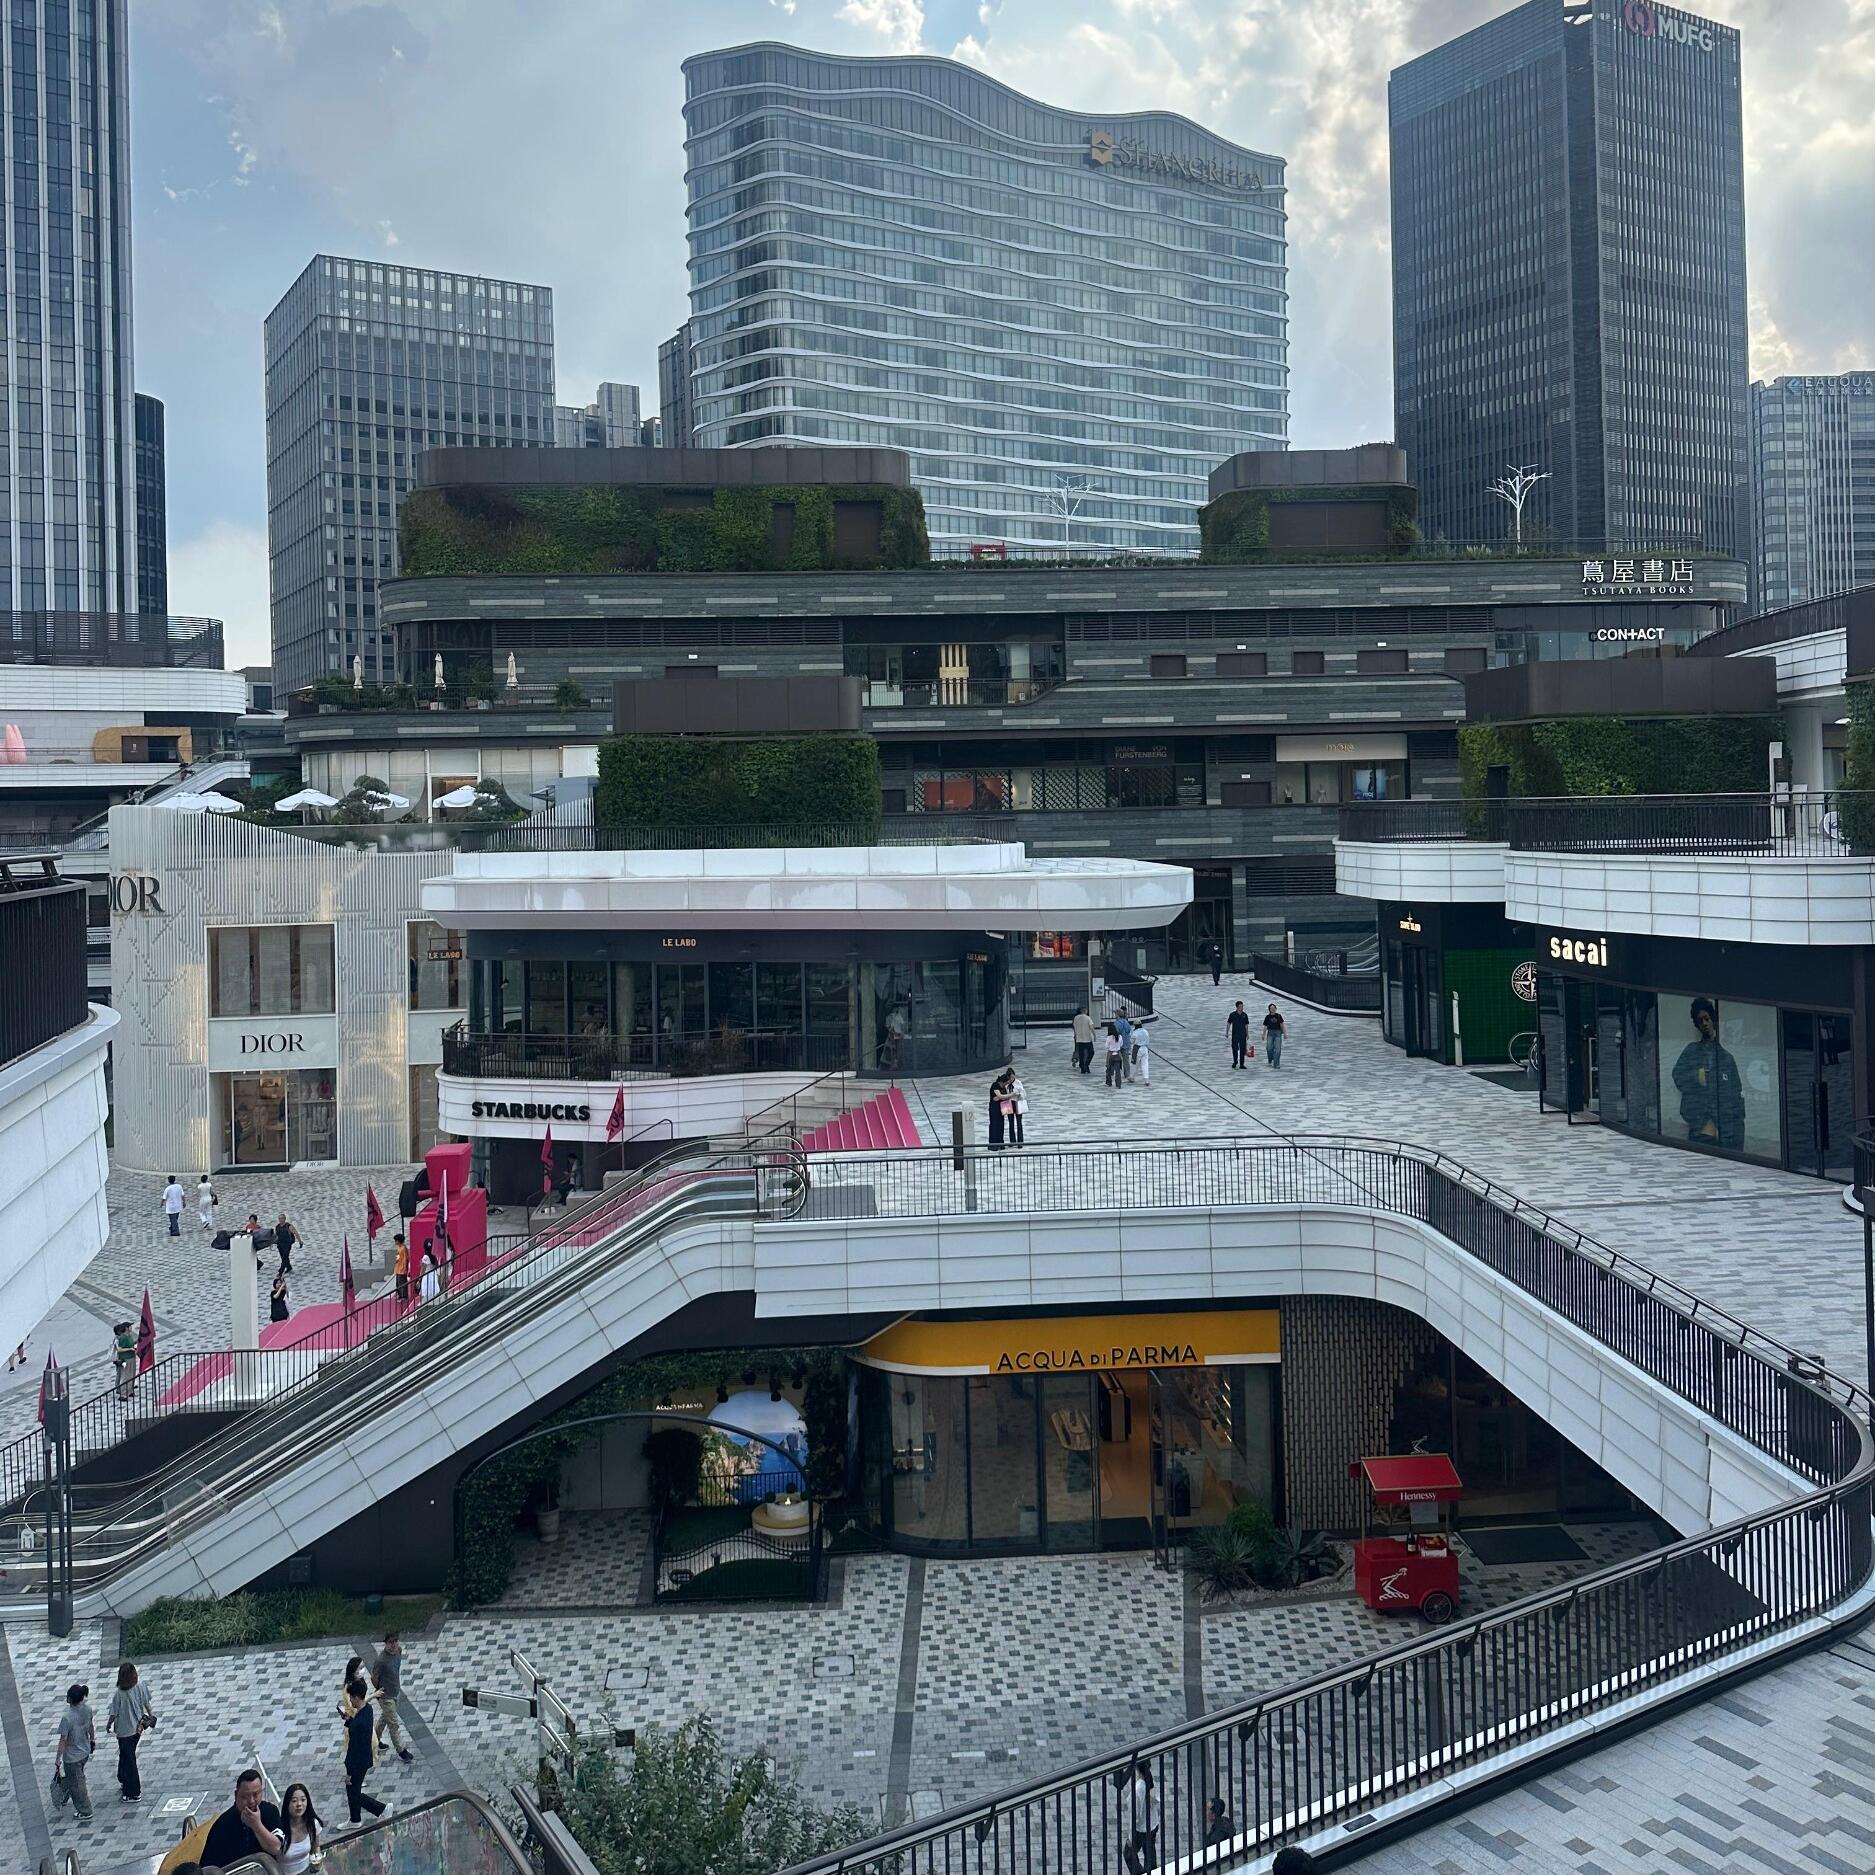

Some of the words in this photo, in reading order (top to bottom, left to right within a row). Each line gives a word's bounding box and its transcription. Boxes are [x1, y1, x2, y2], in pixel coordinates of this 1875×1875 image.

[1657, 14, 1713, 52] MUFG
[1581, 558, 1694, 583] 蔦屋書店
[1582, 586, 1642, 596] TSUTAYA
[1649, 585, 1694, 595] BOOKS
[662, 938, 673, 947] LE
[675, 938, 697, 947] LABO
[1550, 936, 1608, 967] sacai
[240, 1033, 307, 1054] DIOR
[471, 1101, 591, 1122] STARBUCKS
[997, 1349, 1086, 1372] ACQUA
[1090, 1353, 1106, 1365] DI
[1111, 1344, 1198, 1366] PARMA
[1400, 1491, 1437, 1502] Hennessy
